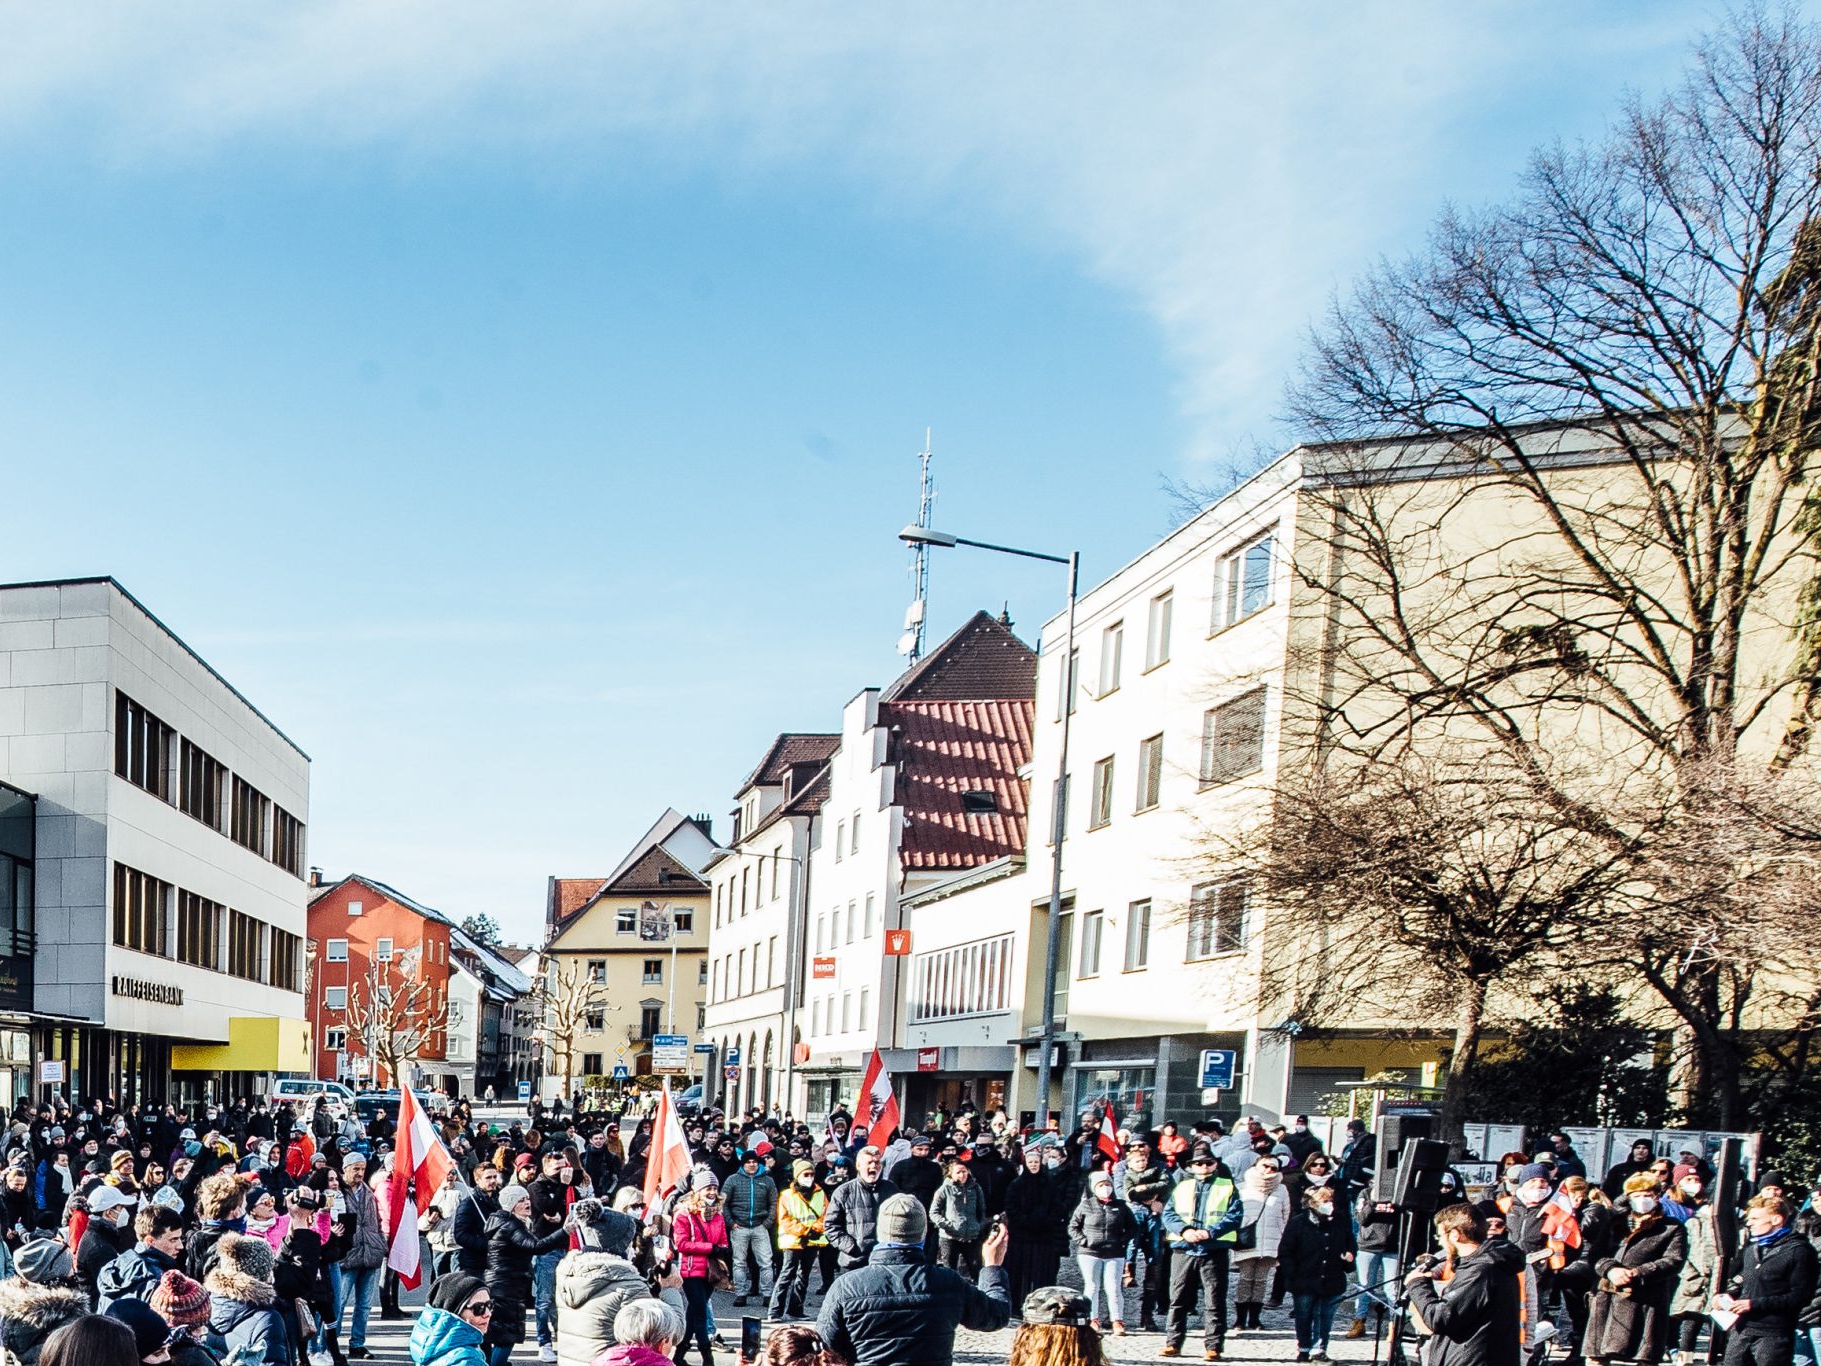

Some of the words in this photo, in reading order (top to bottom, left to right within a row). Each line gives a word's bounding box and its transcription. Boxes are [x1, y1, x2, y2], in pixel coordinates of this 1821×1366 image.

[113, 976, 184, 1006] RAIFFEISENBANK
[726, 1048, 739, 1061] P
[1204, 1052, 1225, 1073] P
